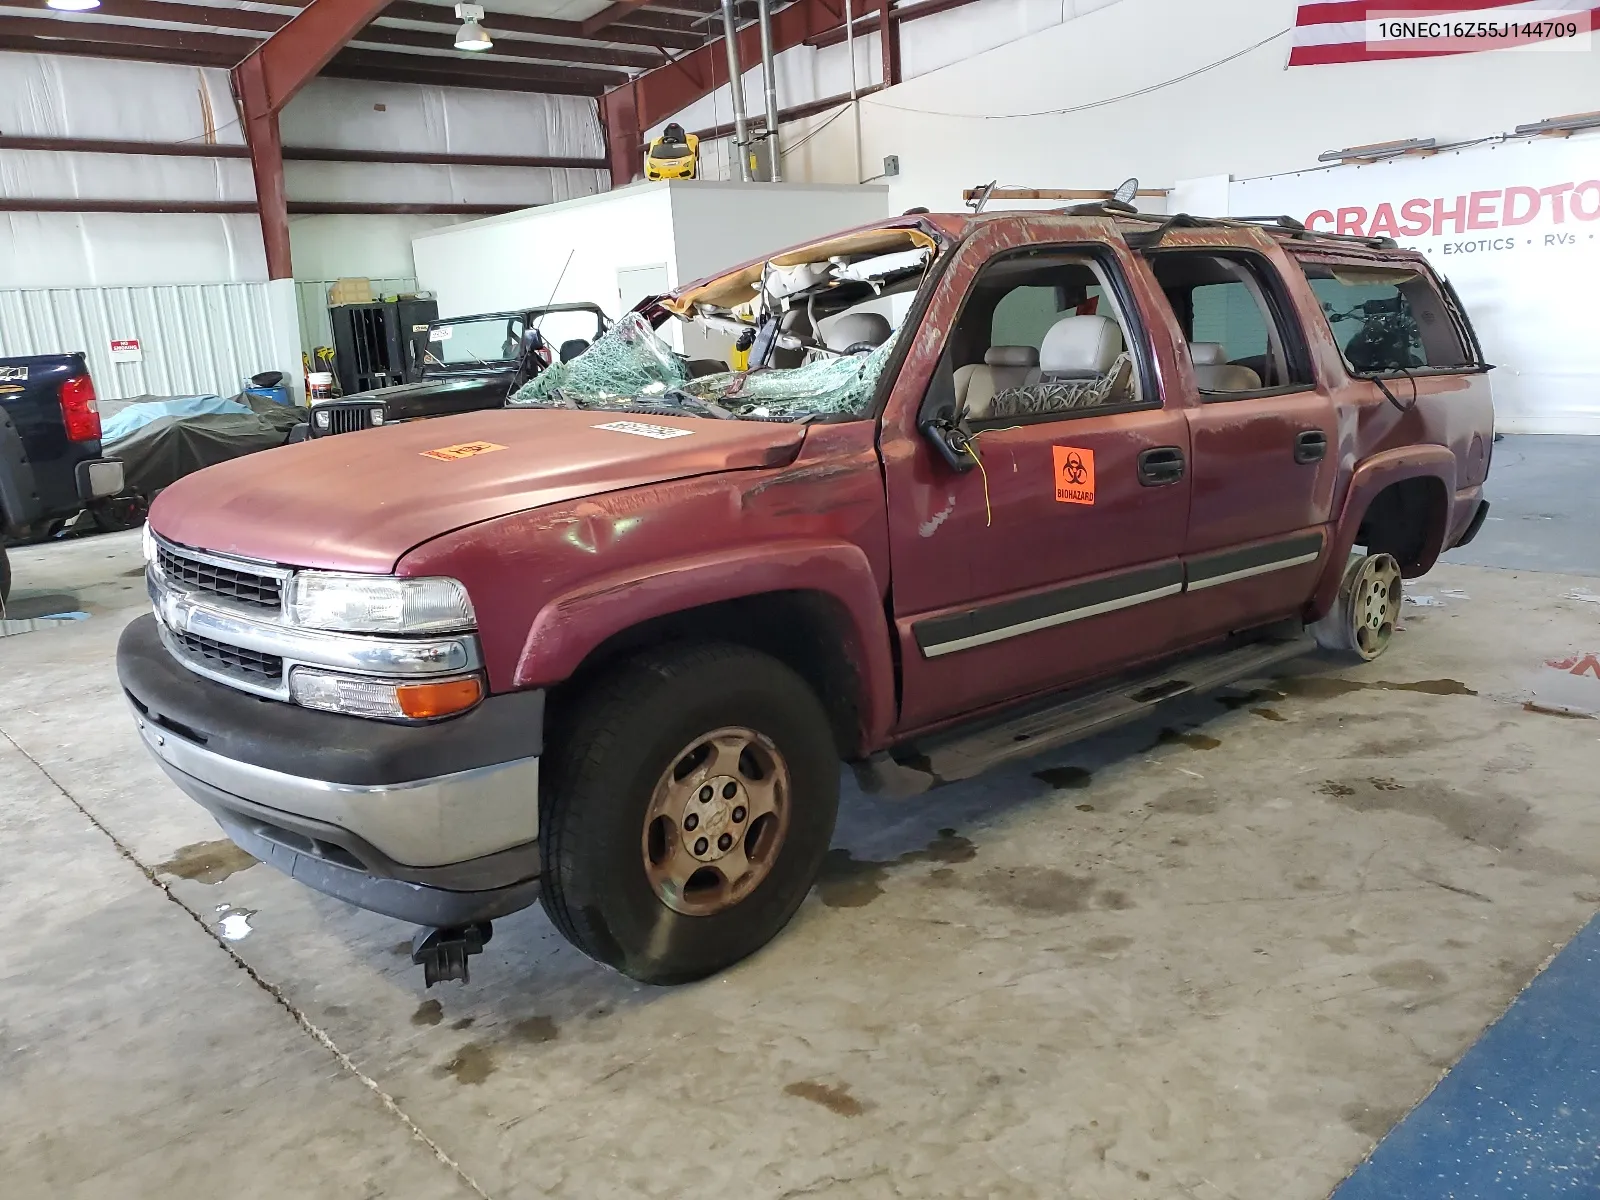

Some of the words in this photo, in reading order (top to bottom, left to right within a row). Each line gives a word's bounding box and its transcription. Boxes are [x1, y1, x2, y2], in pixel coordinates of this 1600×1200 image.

[1443, 237, 1515, 255] EXOTICS
[1544, 232, 1576, 246] RVs
[1057, 488, 1094, 501] BIOHAZARD
